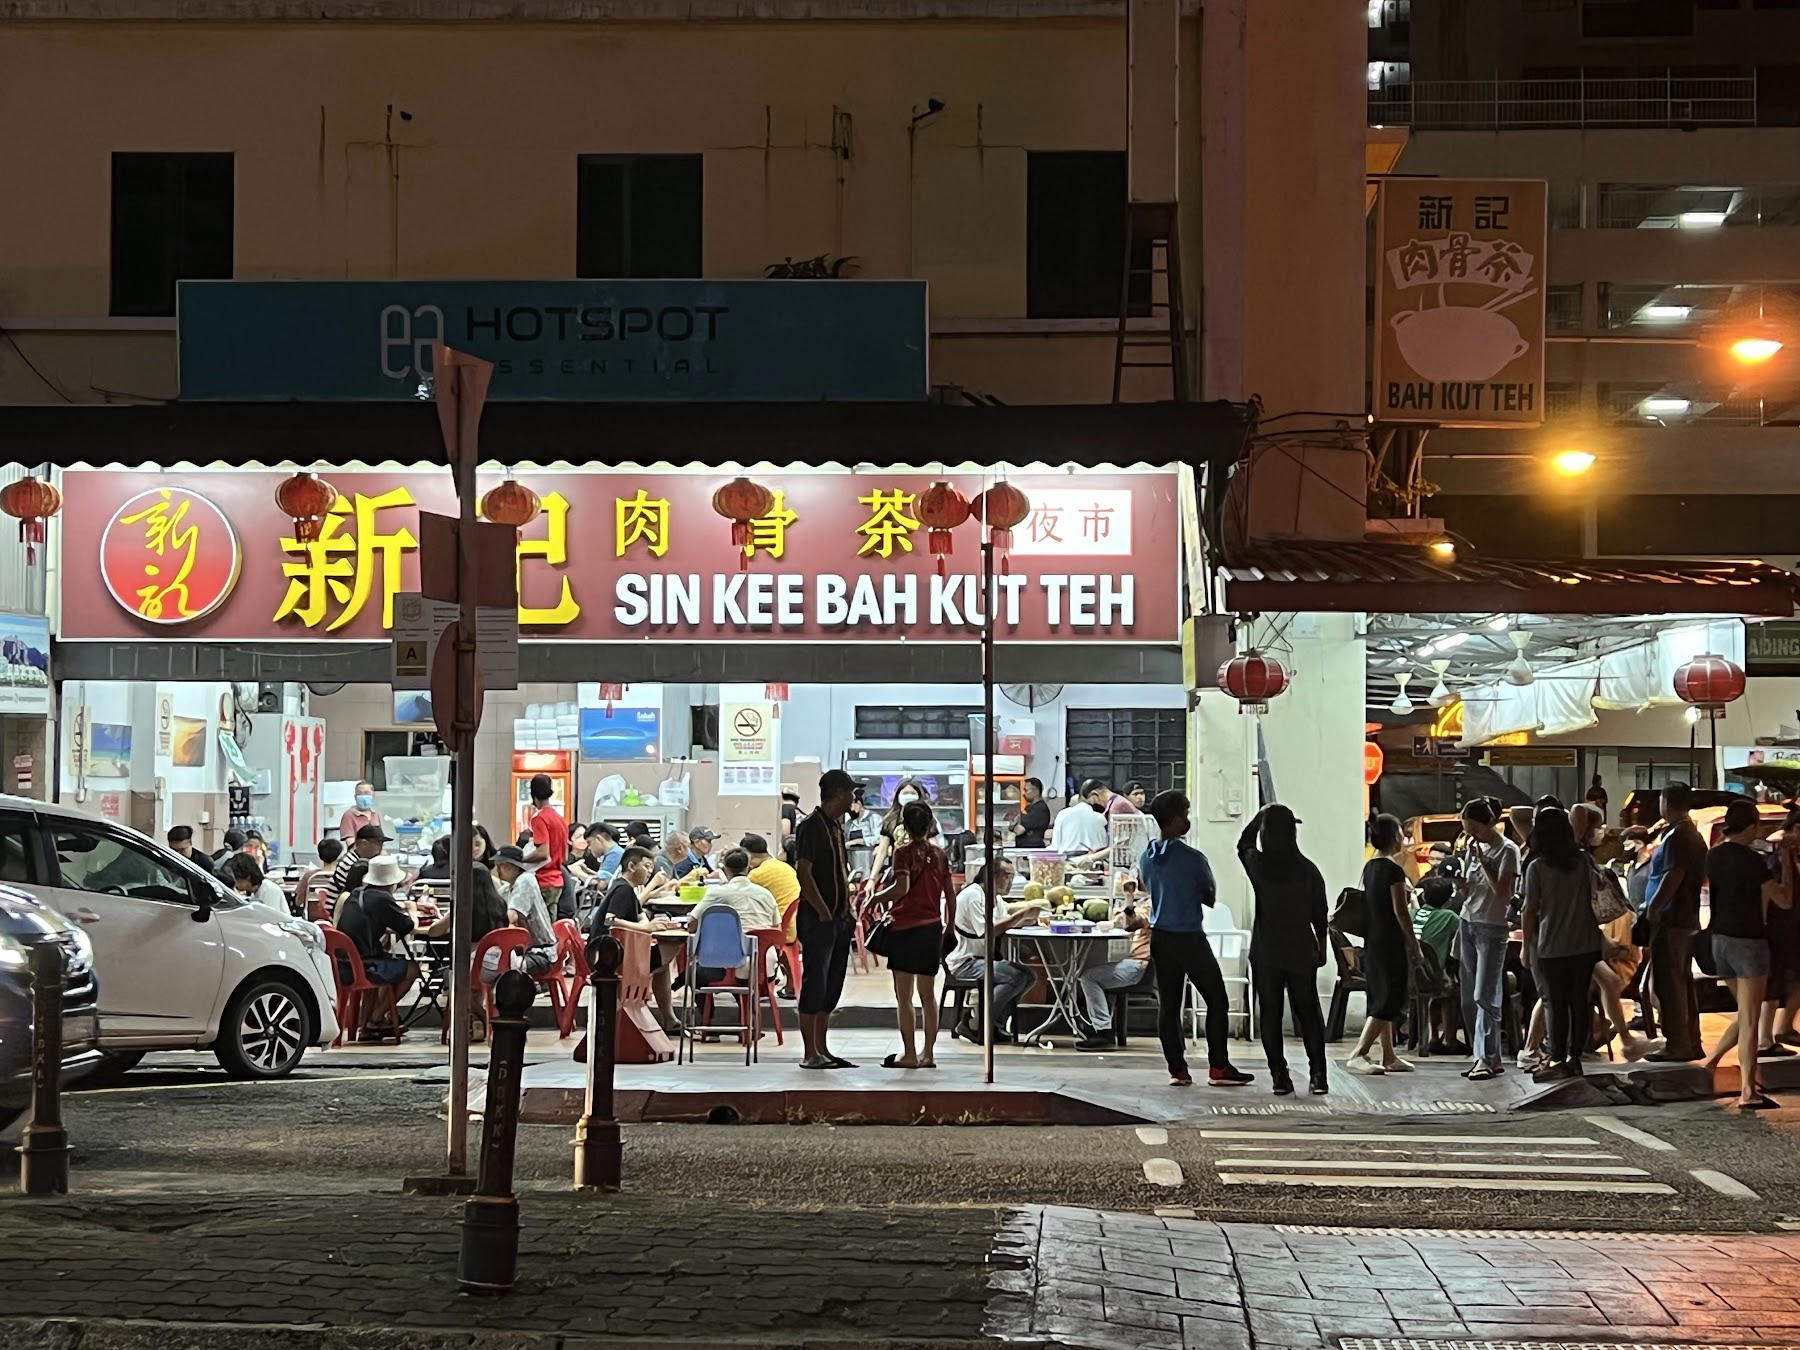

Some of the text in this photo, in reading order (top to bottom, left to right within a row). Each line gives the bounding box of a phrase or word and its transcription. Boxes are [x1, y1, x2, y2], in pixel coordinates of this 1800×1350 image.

[1418, 195, 1510, 230] 新記
[1398, 233, 1523, 283] 肉骨茶
[467, 306, 730, 342] HOTSPOT
[497, 358, 721, 375] SSENTIAL
[1387, 382, 1534, 411] BAH KUT TEH
[1027, 502, 1115, 543] 夜市
[615, 574, 1134, 626] SIN KEE BAH KUT TEH
[406, 647, 417, 660] A
